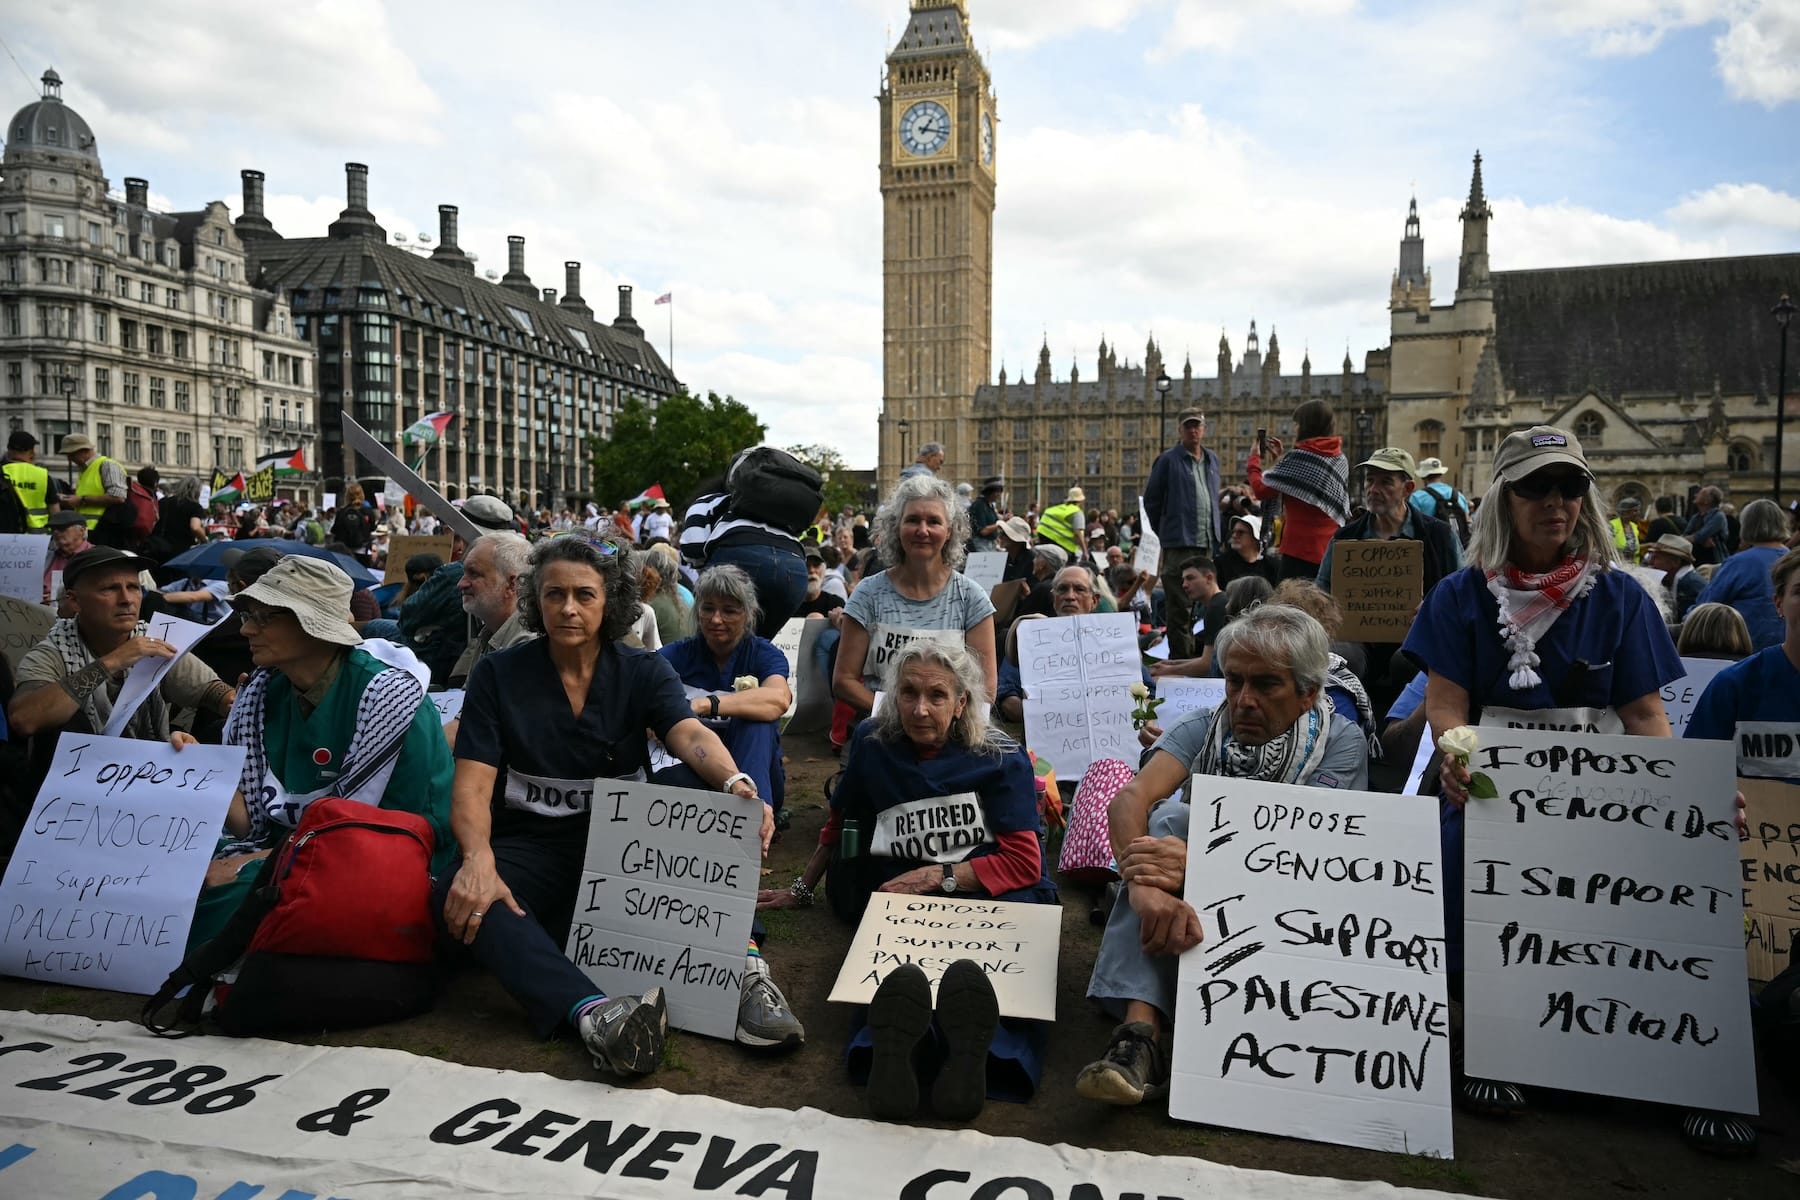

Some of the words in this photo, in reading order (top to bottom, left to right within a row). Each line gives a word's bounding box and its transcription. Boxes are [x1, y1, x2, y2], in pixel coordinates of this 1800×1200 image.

[1342, 565, 1413, 578] GENOCIDE
[1361, 547, 1412, 562] OPPOSE
[1032, 628, 1051, 647] I
[1033, 650, 1126, 674] GENOCIDE
[1061, 685, 1129, 701] SUPPORT
[1044, 711, 1129, 731] PALESTIN
[63, 743, 91, 777] I
[1063, 735, 1121, 753] ACTION
[1741, 733, 1800, 758] MID
[1479, 745, 1523, 769] I
[1525, 745, 1676, 779] OPPOSE
[34, 797, 208, 855] GENOCIDE
[607, 791, 630, 823] I
[647, 799, 748, 841] OPPOSE
[895, 802, 977, 837] RETIRED
[1210, 795, 1232, 833] I
[1254, 804, 1367, 836] OPPOSE
[1509, 788, 1735, 841] GENOCIDE
[890, 826, 986, 861] DOCTOR
[17, 860, 37, 886] I
[621, 839, 741, 890] GENOCIDE
[1244, 842, 1435, 896] GENOCIDE
[1470, 859, 1511, 896] I
[585, 878, 606, 913] I
[624, 887, 732, 938] SUPPORT
[885, 900, 890, 910] I
[906, 902, 1007, 915] OPPOSE
[1203, 894, 1259, 954] I
[4, 904, 182, 948] PALESTINE
[876, 933, 882, 946] I
[894, 935, 1028, 953] SUPPORT
[25, 948, 114, 974] ACTION
[573, 922, 665, 977] PALESTINE
[669, 944, 744, 992] ACTION
[1196, 975, 1449, 1038] PALESTINE
[1539, 991, 1719, 1047] ACTION
[1221, 1032, 1432, 1092] ACTION
[15, 1051, 283, 1115] 2286
[296, 1088, 390, 1136] &
[429, 1098, 819, 1200] GENEVA
